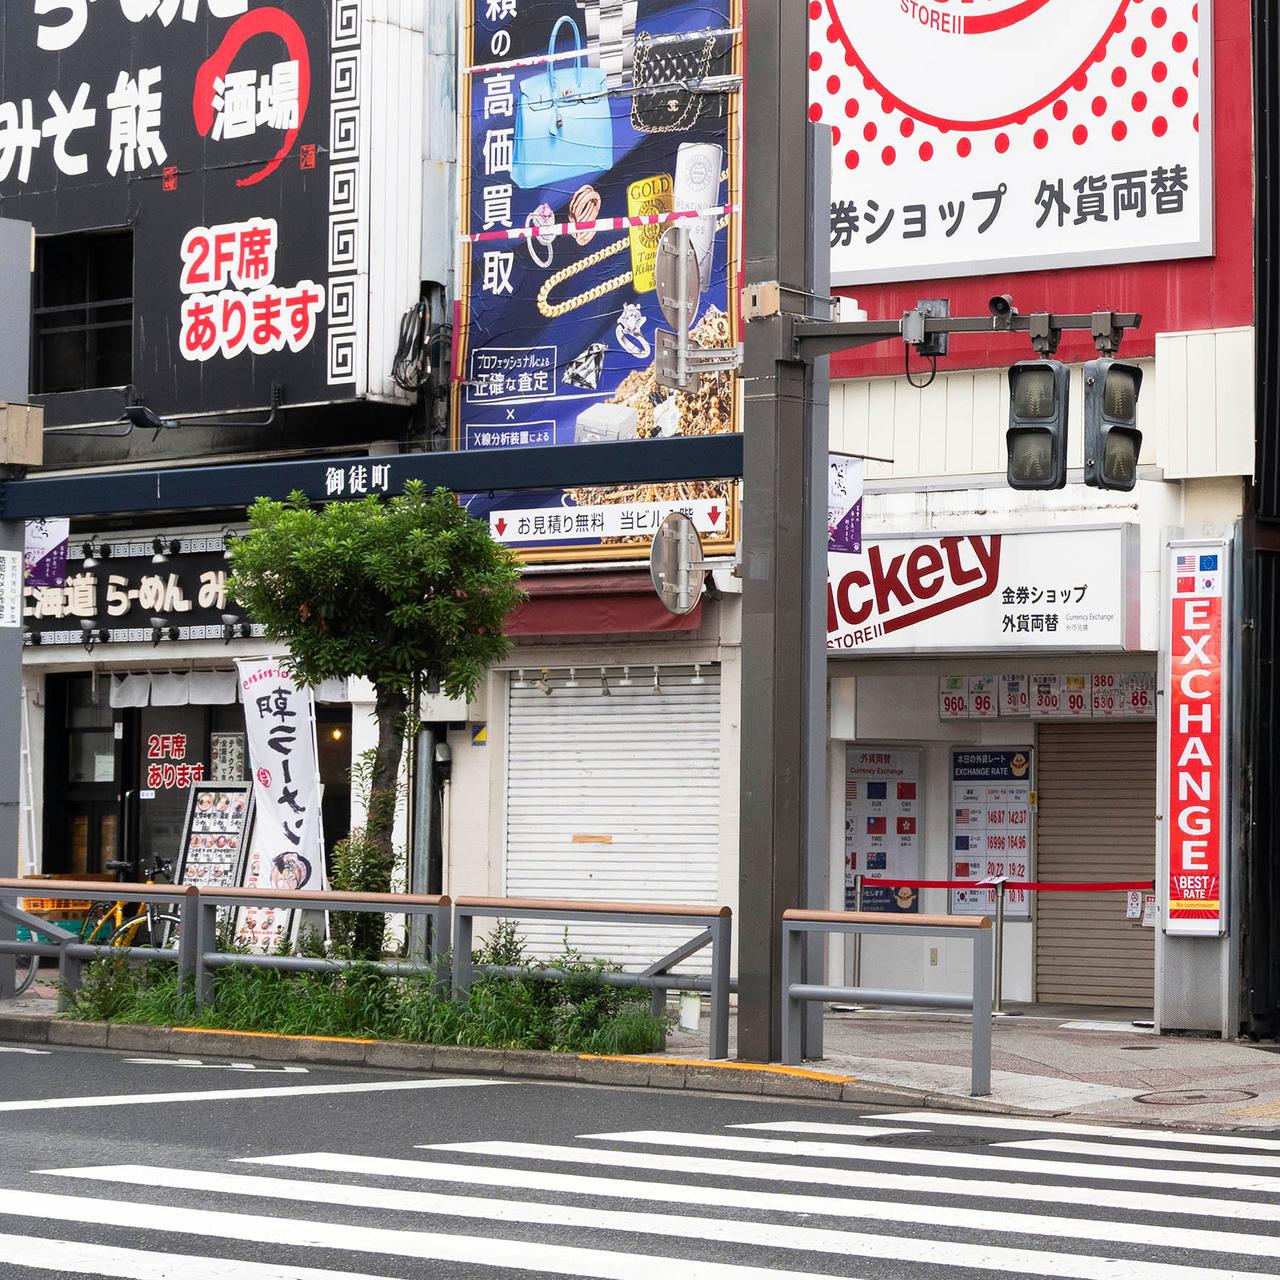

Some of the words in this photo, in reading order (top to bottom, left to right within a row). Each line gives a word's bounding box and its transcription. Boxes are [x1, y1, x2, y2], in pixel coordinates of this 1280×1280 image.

[211, 60, 300, 142] 酒場
[0, 66, 168, 183] みそ熊
[630, 180, 670, 200] GOLD
[1034, 164, 1190, 230] 外貨両替
[186, 227, 272, 285] 2F席
[185, 290, 320, 351] あります
[325, 464, 391, 496] 御徒町
[517, 513, 604, 535] お見積り無料
[106, 573, 192, 617] らーめん
[1002, 584, 1088, 605] 金券ショップ
[1002, 613, 1059, 632] 外貨両替
[147, 733, 187, 760] 2F席
[1176, 601, 1213, 871] EXCHANGE
[955, 767, 990, 776] EXCHANGE
[991, 767, 1008, 776] RATE
[1180, 875, 1210, 889] BEST
[1183, 889, 1206, 899] RATE
